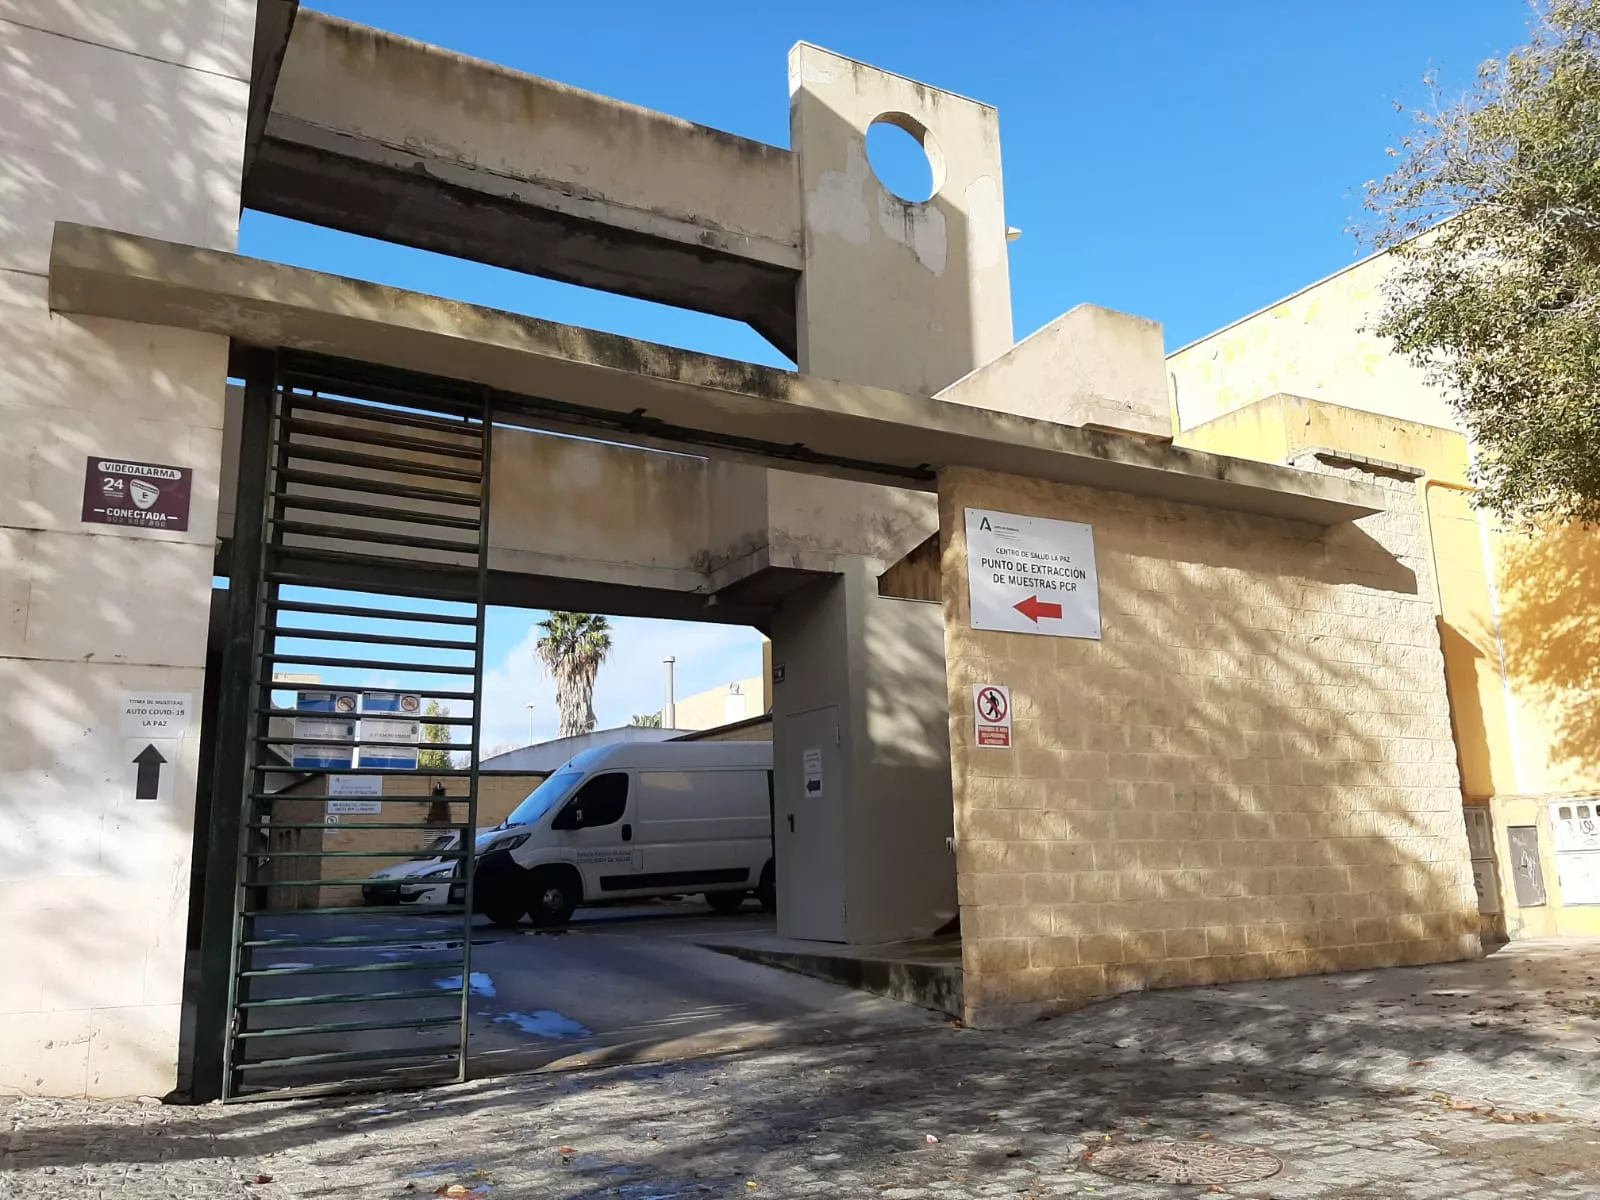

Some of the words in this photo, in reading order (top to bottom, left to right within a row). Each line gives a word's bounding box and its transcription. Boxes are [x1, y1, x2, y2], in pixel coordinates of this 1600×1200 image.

[104, 463, 176, 479] VIDEOALARMA
[103, 477, 124, 491] 24
[106, 507, 167, 521] CONECTADA
[995, 547, 1020, 557] CENTRO
[1030, 552, 1050, 561] SALUD
[1060, 555, 1071, 563] PAZ
[981, 558, 1014, 571] PUNTO
[1016, 562, 1029, 573] DE
[993, 573, 1005, 584] DE
[1008, 576, 1057, 590] MUESTRAS
[1059, 581, 1077, 592] PCR
